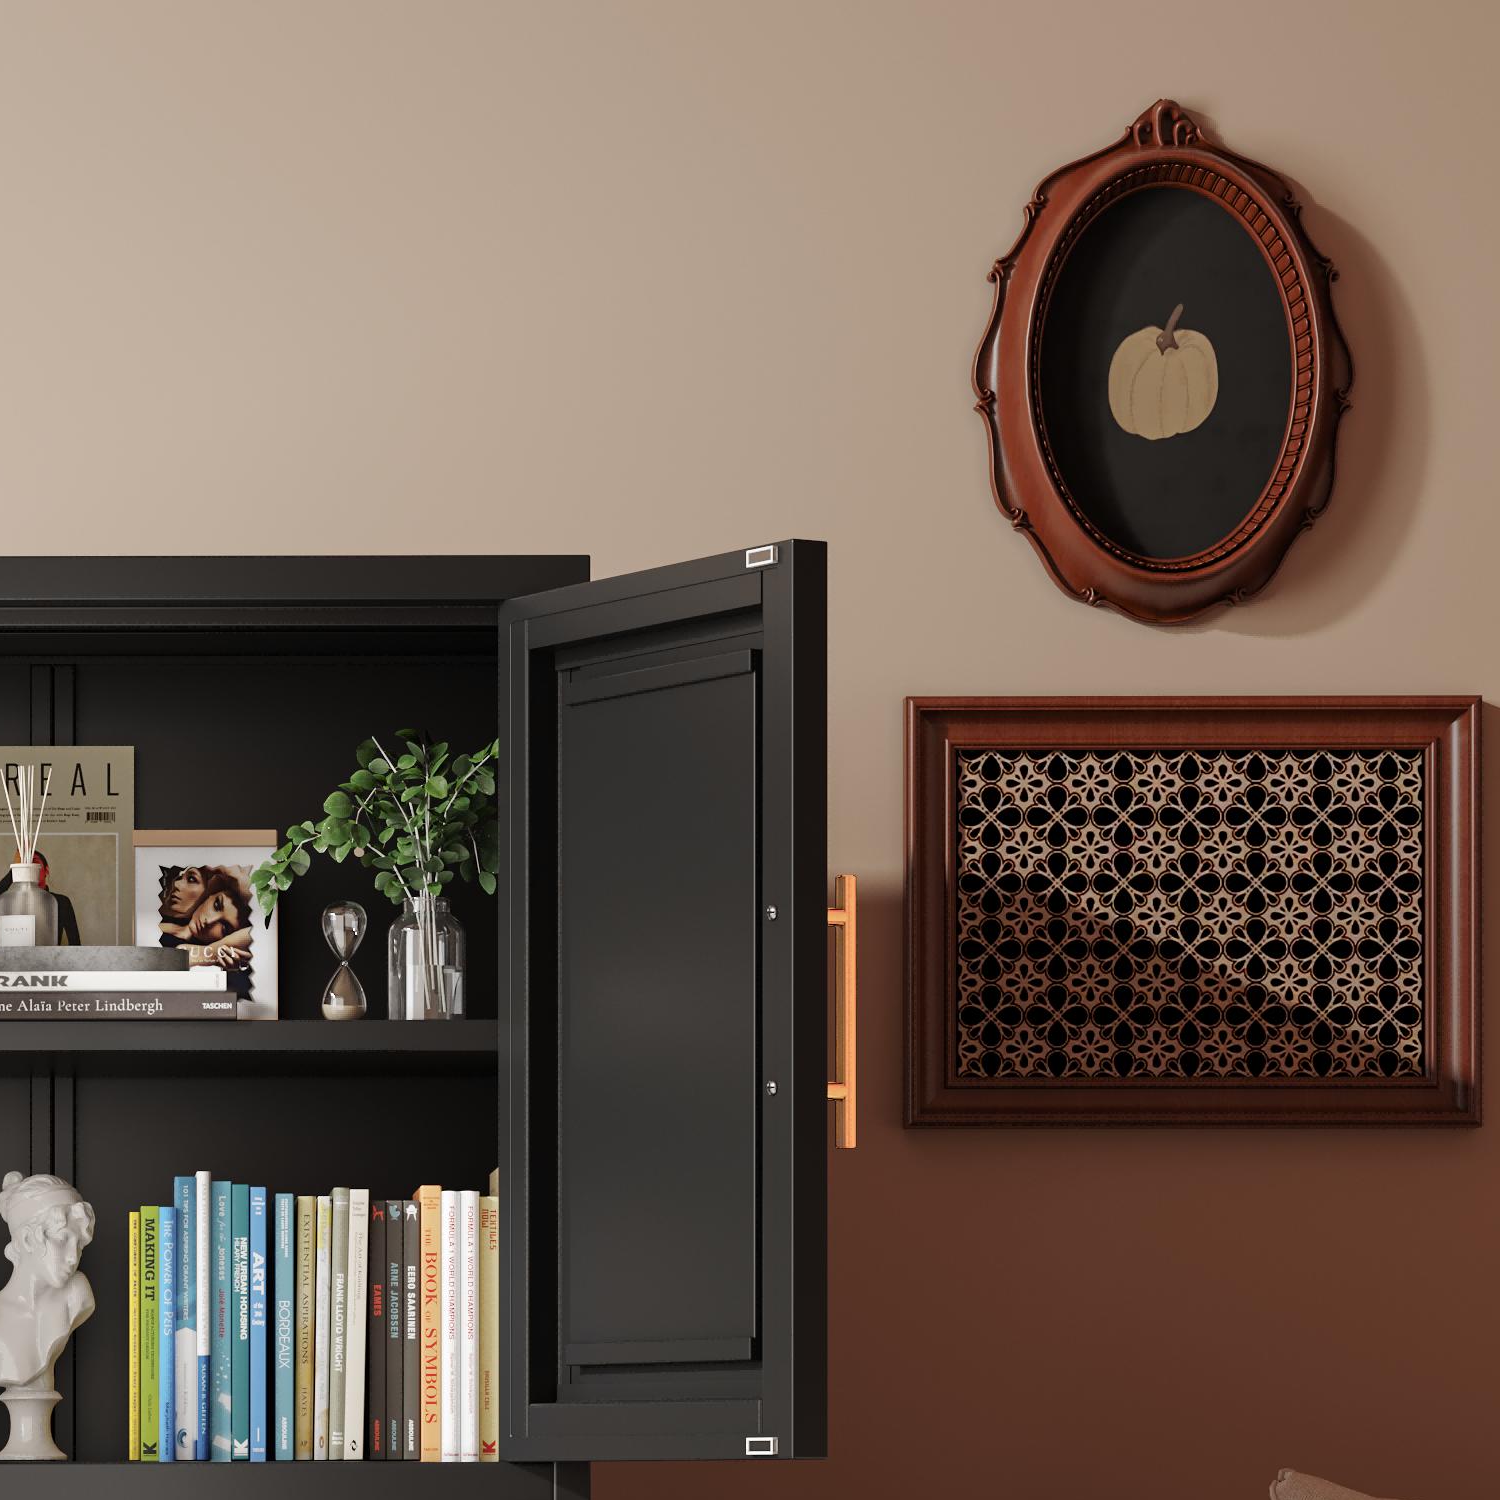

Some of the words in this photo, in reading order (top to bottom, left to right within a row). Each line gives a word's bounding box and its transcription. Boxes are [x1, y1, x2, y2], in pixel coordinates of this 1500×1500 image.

[17, 998, 52, 1012] Alaïa
[58, 1000, 91, 1012] Peter
[95, 998, 164, 1016] Lindbergh
[201, 1002, 233, 1010] TASCHEN
[218, 1195, 227, 1217] Love
[163, 1220, 174, 1238] THE
[145, 1218, 155, 1281] MAKING
[218, 1245, 226, 1281] Joneses
[240, 1237, 248, 1260] NEW
[302, 1214, 310, 1288] EXISTENTIAL
[239, 1261, 248, 1295] URBAN
[252, 1251, 265, 1296] ART
[336, 1273, 344, 1303] FRANK
[390, 1262, 399, 1287] ARNE
[407, 1265, 416, 1290] EERO
[425, 1251, 438, 1306] BOOK
[145, 1286, 155, 1302] IT
[163, 1288, 173, 1305] OF
[373, 1284, 382, 1317] EAMES
[239, 1296, 248, 1341] HOUSING
[335, 1304, 344, 1335] LLOYD
[390, 1289, 399, 1339] JACOBSEN
[407, 1292, 416, 1340] SAARINEN
[278, 1300, 291, 1369] BORDEAUX
[334, 1335, 343, 1373] WRIGHT
[425, 1327, 438, 1424] SYMBOLS
[300, 1387, 308, 1417] HAYES
